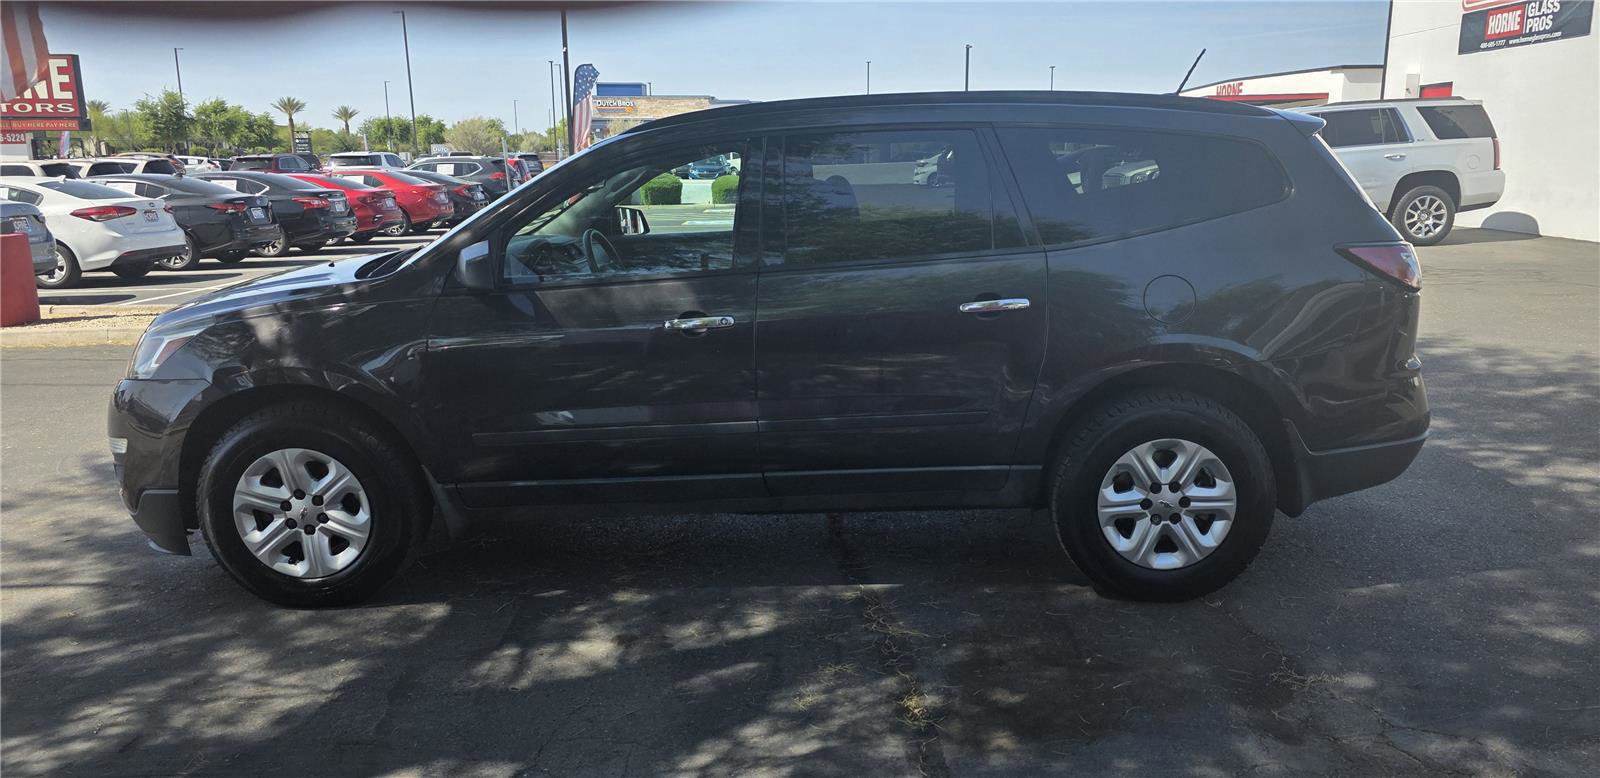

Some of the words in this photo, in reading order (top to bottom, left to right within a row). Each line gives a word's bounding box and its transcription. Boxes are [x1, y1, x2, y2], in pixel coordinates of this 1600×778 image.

[1528, 0, 1560, 17] GLASS
[1487, 10, 1522, 34] HORNE
[1526, 15, 1553, 33] PROS
[0, 102, 75, 113] TORS
